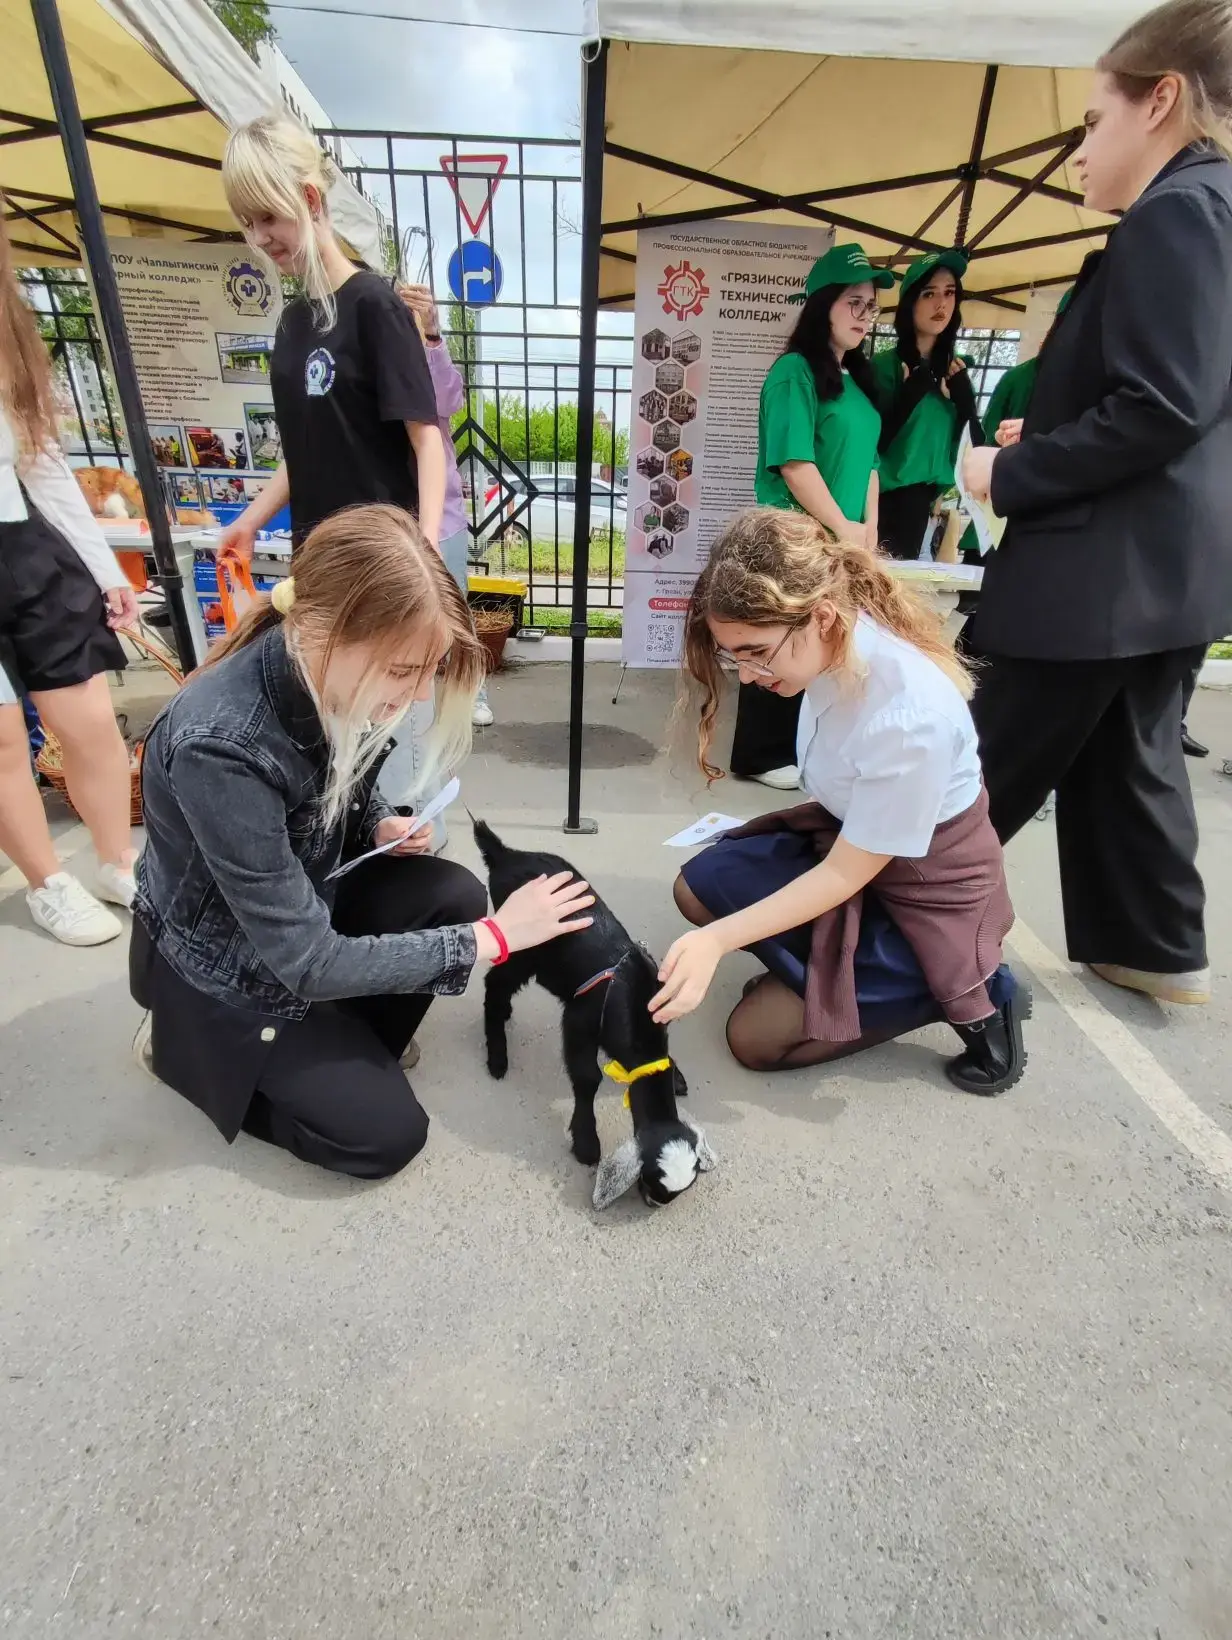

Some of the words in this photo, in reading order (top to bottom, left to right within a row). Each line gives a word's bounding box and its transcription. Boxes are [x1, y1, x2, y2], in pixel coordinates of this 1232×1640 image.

[670, 234, 730, 246] ГОСУДАРСТВЕННОЕ
[731, 238, 768, 248] ОБЛАСТНОЕ
[769, 242, 808, 251] БЮДЖЕТНОЕ
[653, 242, 721, 255] ПРОФЕССИОНАЛЬНОЕ
[722, 248, 781, 259] ОБРАЗОВАТЕЛЬНОЕ
[782, 254, 823, 262] УЧРЕЖДЕНИ
[110, 254, 133, 265] ПОУ
[136, 256, 219, 272] «Чаплыгинский
[116, 270, 146, 281] рный
[149, 273, 201, 285] колледж»
[673, 285, 694, 297] ГТК
